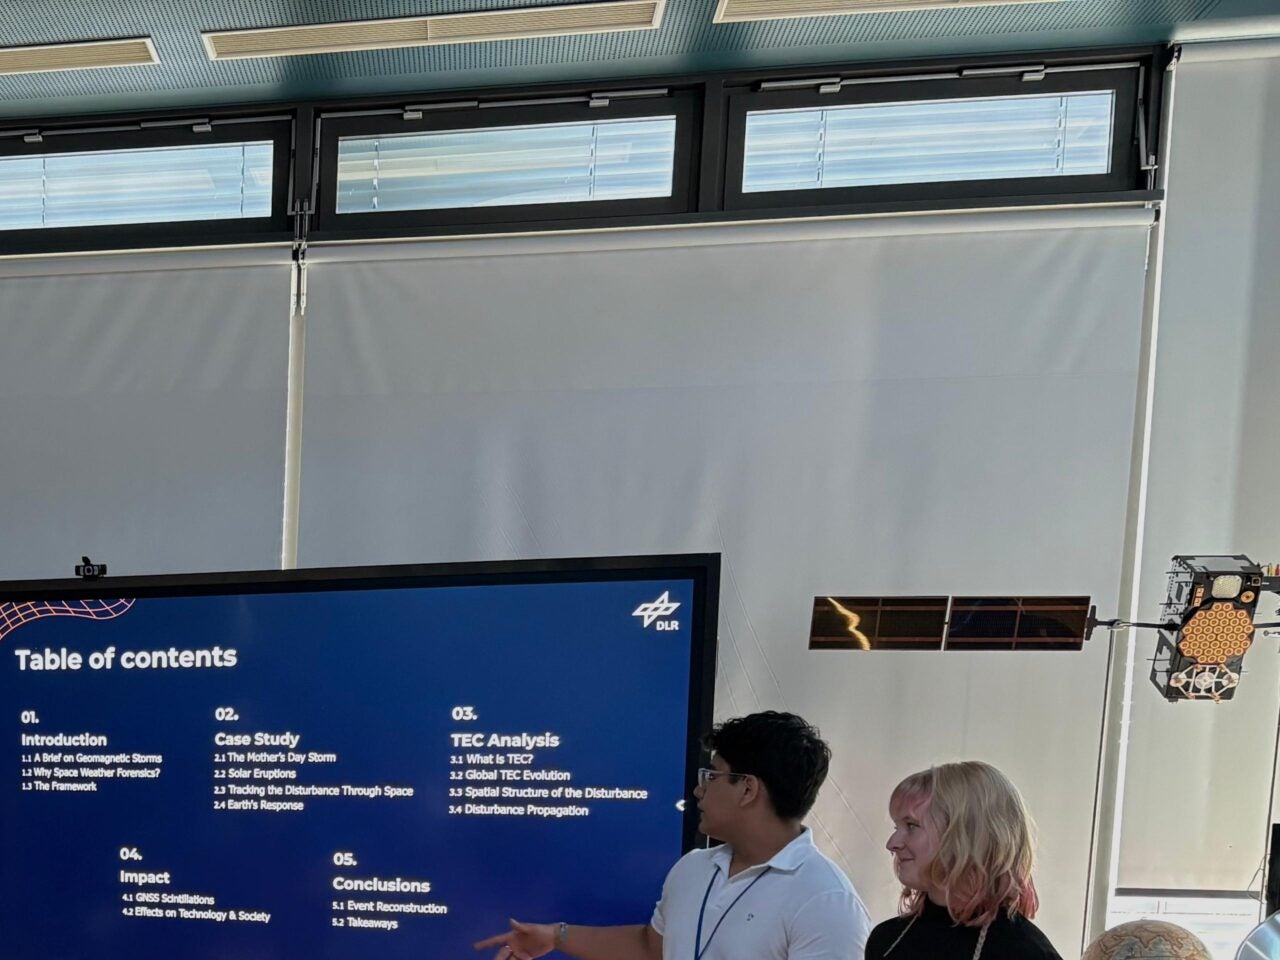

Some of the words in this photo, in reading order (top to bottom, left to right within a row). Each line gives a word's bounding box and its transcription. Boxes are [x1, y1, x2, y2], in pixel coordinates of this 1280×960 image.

[656, 620, 679, 631] DLR
[15, 648, 82, 671] Table
[88, 646, 116, 669] of
[120, 646, 238, 669] contents
[21, 711, 40, 724] 01.
[215, 707, 239, 721] 02.
[451, 706, 477, 721] 03.
[21, 733, 108, 747] Introduction
[214, 732, 251, 746] Case
[254, 731, 300, 748] Study
[450, 733, 485, 748] TEC
[487, 732, 560, 750] Analysis
[22, 754, 32, 763] 1.1
[34, 753, 41, 763] A
[42, 753, 62, 763] Brief
[63, 755, 74, 763] on
[76, 753, 130, 765] Geomagnetic
[132, 753, 163, 764] Storms
[214, 753, 226, 763] 2.1
[227, 752, 245, 763] The
[247, 752, 286, 763] Mother's
[287, 752, 306, 764] Day
[308, 753, 337, 763] Storm
[449, 755, 464, 764] 3.1
[466, 753, 493, 764] What
[495, 754, 505, 764] is
[507, 754, 534, 764] TEC?
[22, 768, 32, 777] 1.2
[33, 767, 52, 778] Why
[53, 768, 78, 779] Space
[80, 767, 115, 778] Weather
[116, 767, 161, 778] Forensics?
[214, 770, 226, 779] 2.2
[228, 768, 251, 779] Solar
[253, 768, 297, 780] Eruptions
[449, 771, 464, 780] 3.2
[465, 769, 497, 781] Global
[499, 769, 521, 780] TEC
[522, 770, 571, 781] Evolution
[22, 782, 32, 791] 1.3
[33, 781, 50, 791] The
[51, 781, 97, 792] Framework
[214, 786, 226, 795] 2.3
[228, 784, 266, 797] Tracking
[267, 784, 283, 795] the
[284, 785, 340, 796] Disturbance
[341, 785, 382, 798] Through
[383, 786, 414, 798] Space
[449, 788, 463, 797] 3.3
[465, 787, 499, 799] Spatial
[501, 787, 548, 798] Structure
[551, 787, 564, 798] of
[565, 788, 582, 798] the
[584, 788, 648, 799] Disturbance
[213, 801, 225, 810] 2.4
[227, 799, 258, 810] Earth's
[260, 800, 304, 812] Response
[448, 805, 462, 814] 3.4
[464, 804, 524, 815] Disturbance
[526, 805, 589, 818] Propagation
[120, 847, 143, 860] 04.
[333, 852, 357, 866] 05.
[120, 870, 170, 886] Impact
[332, 877, 431, 893] Conclusions
[122, 894, 133, 902] 4.1
[135, 892, 160, 903] GNSS
[161, 893, 215, 905] Scintillations
[332, 901, 345, 910] 5.1
[347, 900, 375, 911] Event
[376, 901, 448, 914] Reconstruction
[122, 908, 133, 916] 4.2
[135, 906, 164, 918] Effects
[165, 909, 177, 918] on
[178, 907, 228, 922] Technology
[229, 910, 237, 920] &
[238, 910, 271, 924] Society
[332, 918, 345, 927] 5.2
[346, 916, 399, 931] Takeaways
